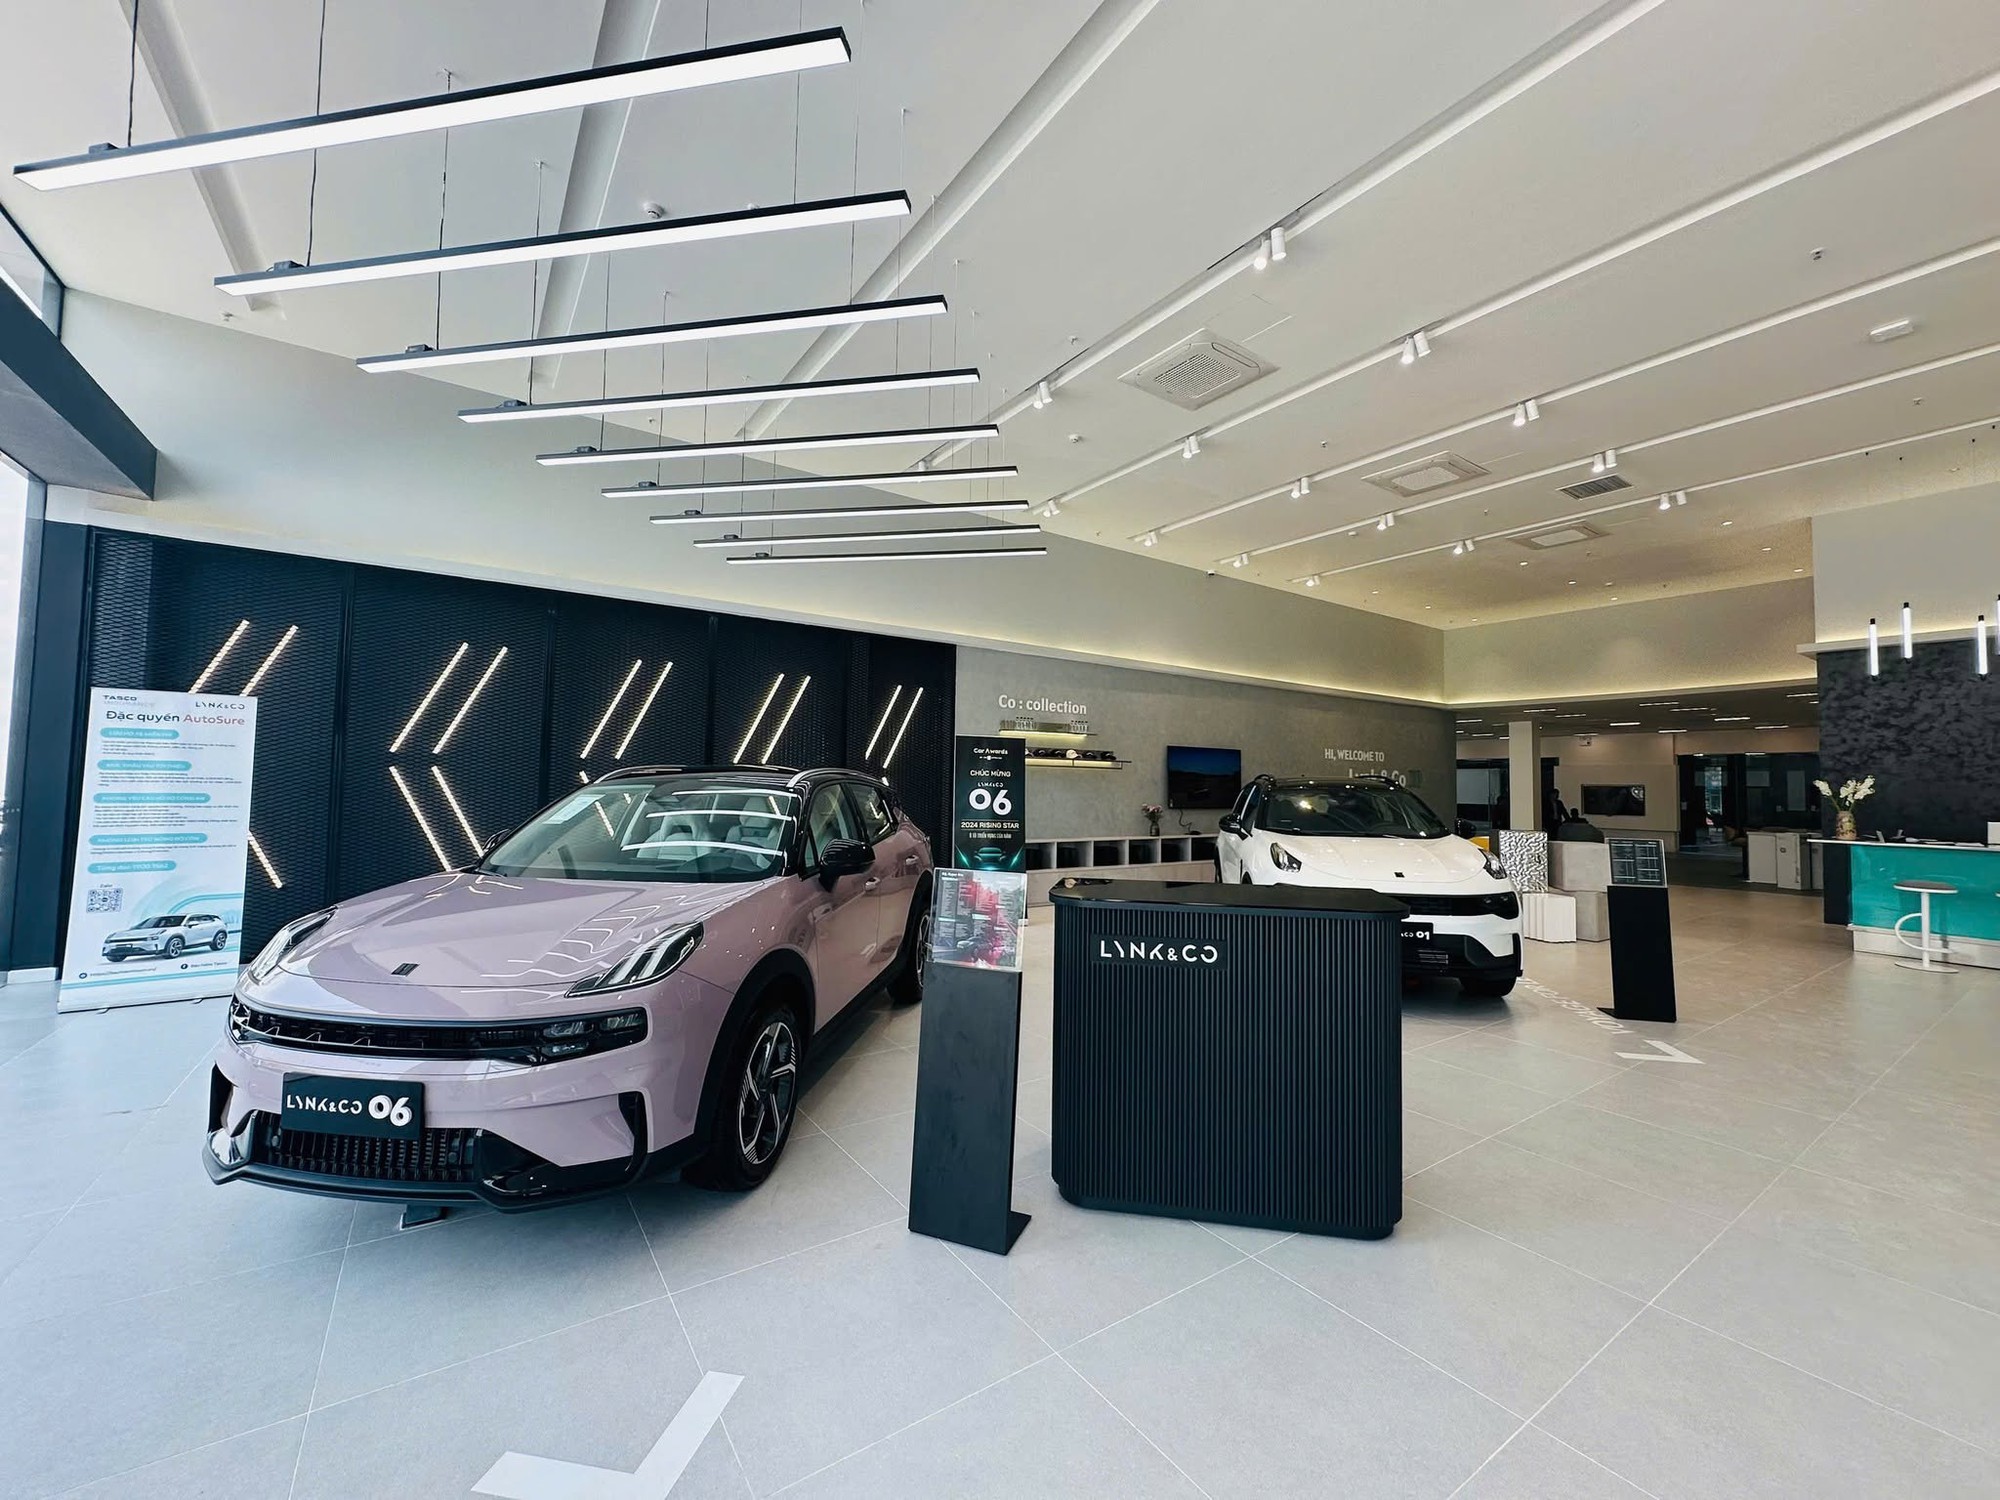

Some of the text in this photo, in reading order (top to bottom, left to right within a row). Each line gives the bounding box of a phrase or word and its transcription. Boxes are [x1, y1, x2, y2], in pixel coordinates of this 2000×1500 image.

[998, 694, 1016, 709] Co
[1026, 697, 1087, 715] collection
[106, 710, 134, 722] Đặc
[183, 714, 245, 725] AutoSure
[1324, 748, 1385, 762] HI, WELCOME TO
[970, 769, 990, 777] CHÚC
[969, 788, 1012, 816] 06
[1416, 930, 1430, 940] 01
[1100, 940, 1218, 964] LYNK&CO
[286, 1094, 413, 1127] LYNK&CO 06
